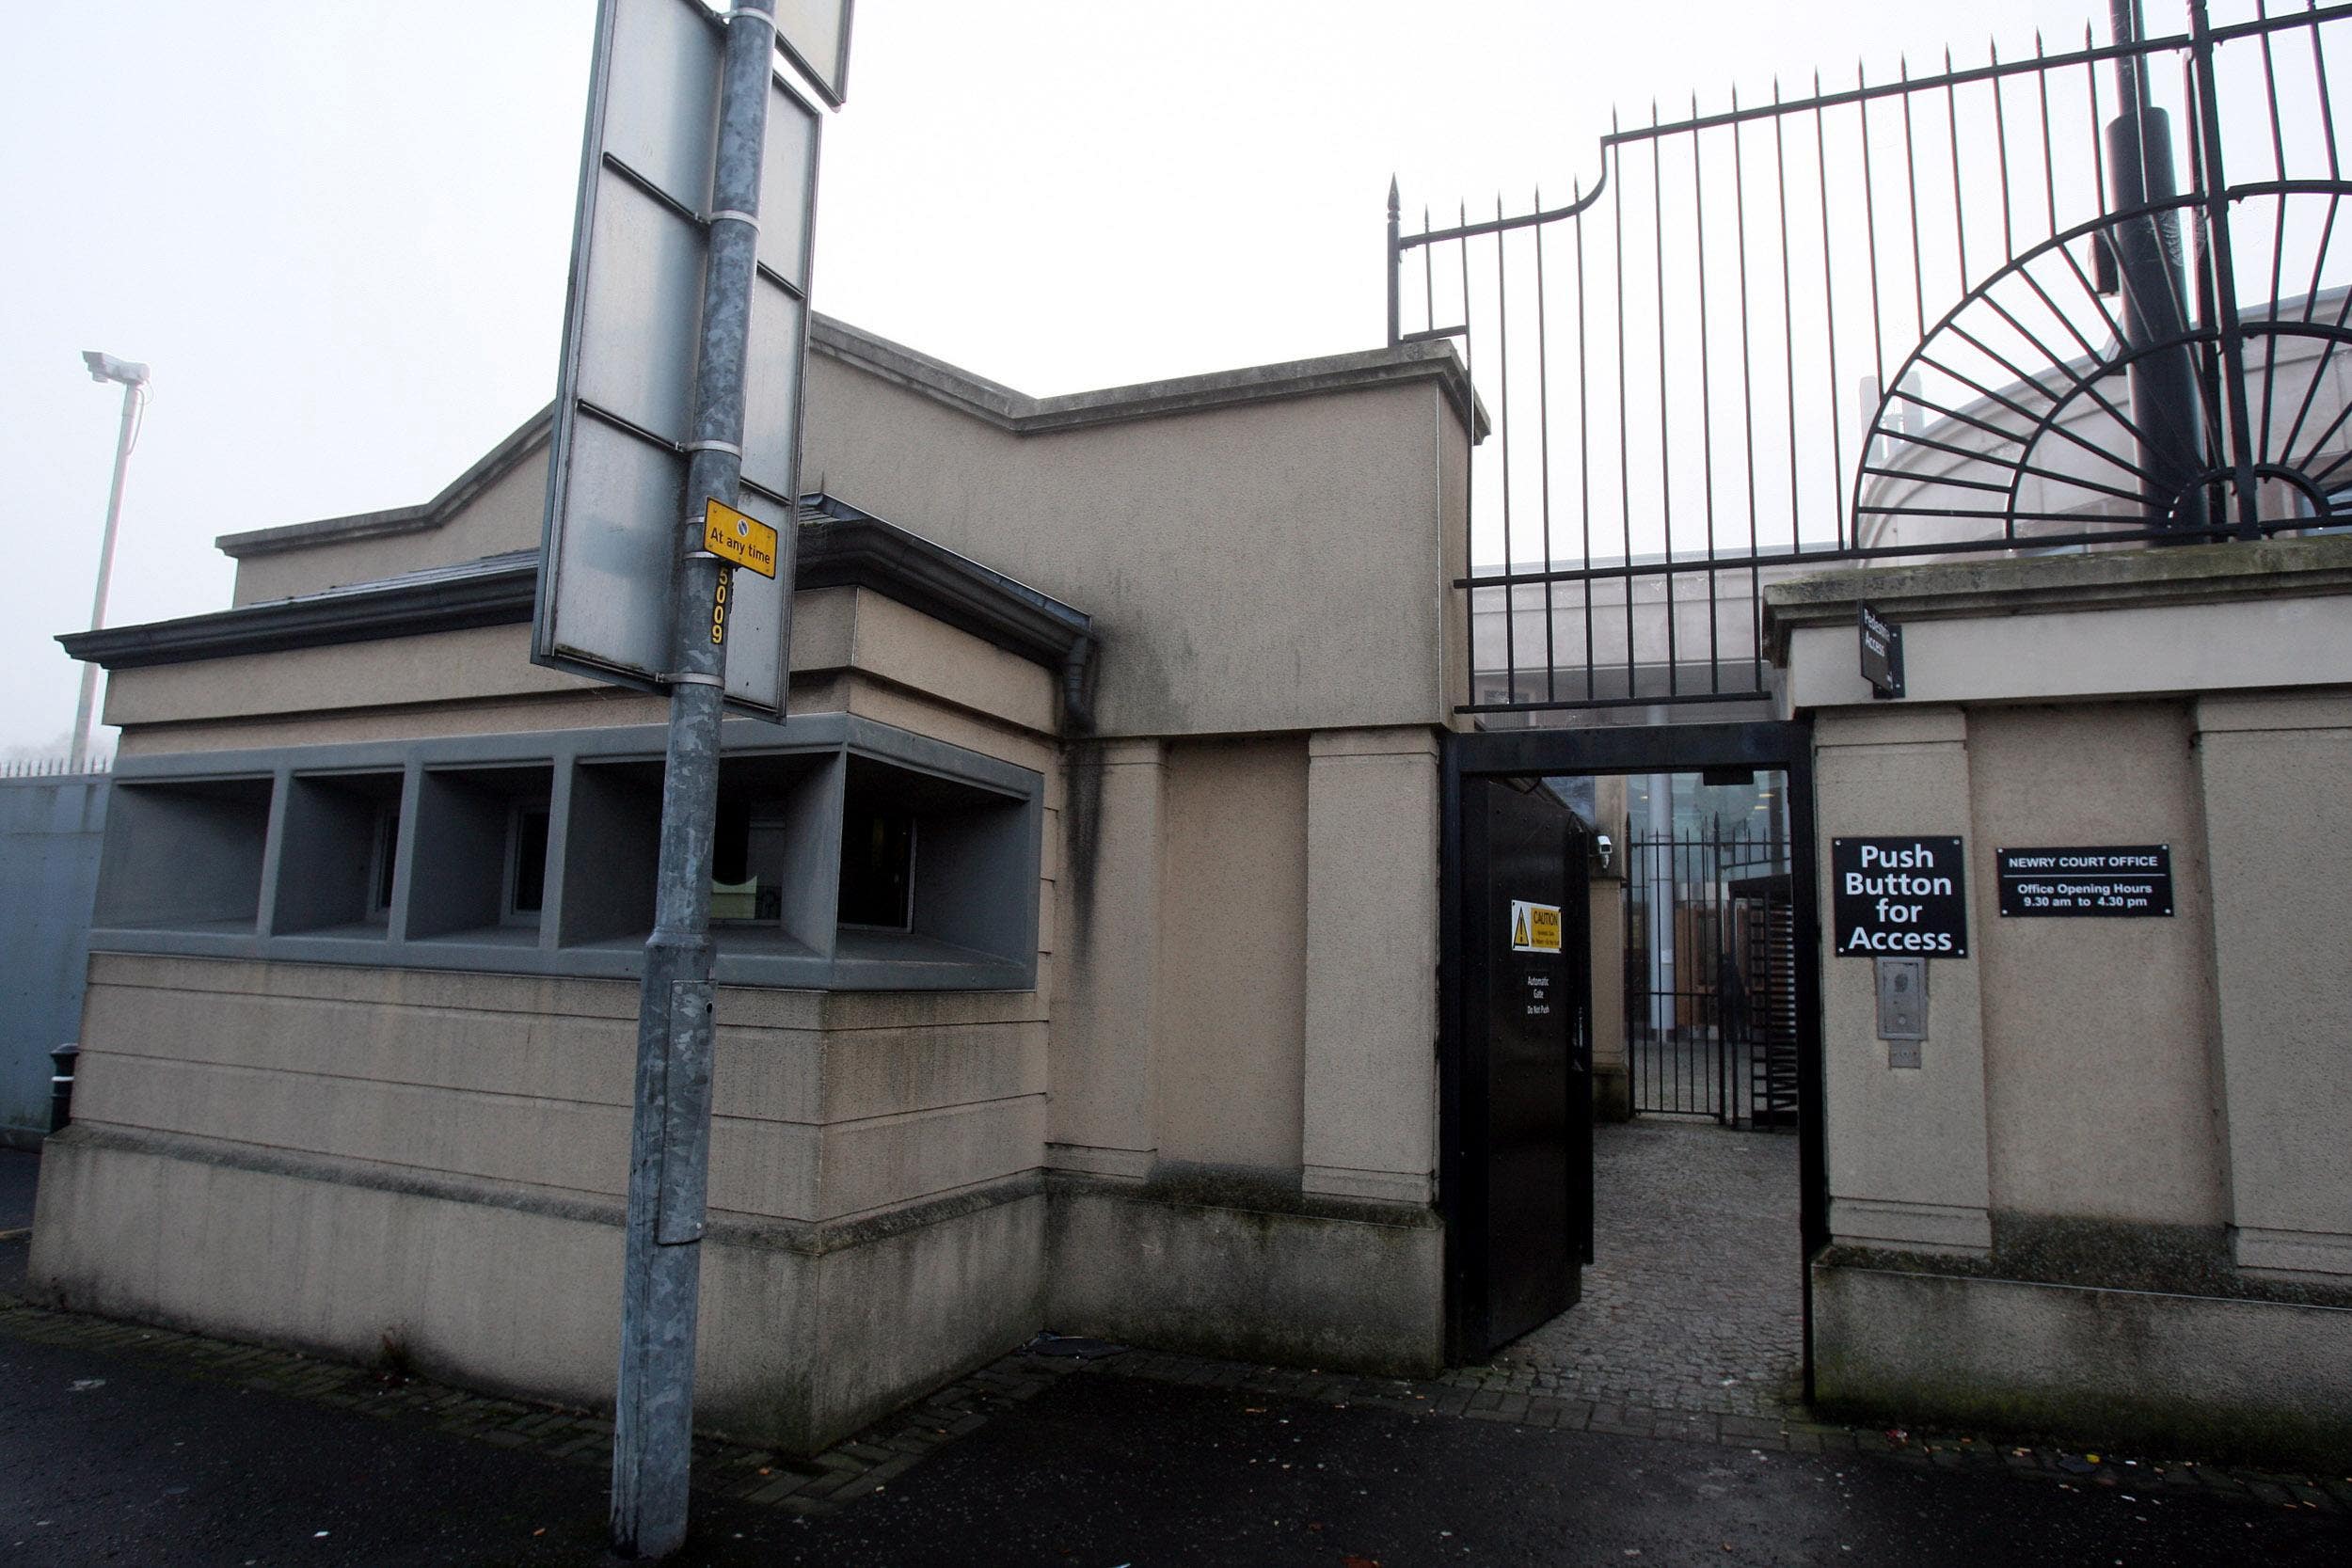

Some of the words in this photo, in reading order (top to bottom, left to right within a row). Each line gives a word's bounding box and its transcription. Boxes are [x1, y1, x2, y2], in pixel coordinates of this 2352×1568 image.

[710, 527, 723, 544] At
[726, 537, 745, 556] any
[748, 544, 771, 564] time
[712, 566, 728, 644] 5009
[1866, 630, 1885, 657] Access
[1861, 843, 1934, 868] Push
[2009, 857, 2056, 868] NEWRY
[2058, 856, 2106, 867] COURT
[2108, 856, 2158, 867] OFFICE
[1846, 872, 1952, 895] Button
[2017, 883, 2054, 895] Office
[2057, 883, 2110, 895] Opening
[2113, 883, 2153, 894] Hours
[1875, 897, 1923, 923] for
[2024, 896, 2049, 907] 9.30
[2052, 898, 2072, 907] am
[2077, 896, 2091, 907] to
[2097, 896, 2123, 907] 4.30
[2126, 898, 2148, 909] pm
[1534, 911, 1558, 927] CAUTION
[1848, 927, 1952, 951] Access
[1527, 975, 1549, 986] Automatic
[1534, 989, 1544, 999] Gate
[1527, 1006, 1534, 1014] Do
[1541, 1004, 1550, 1014] Push
